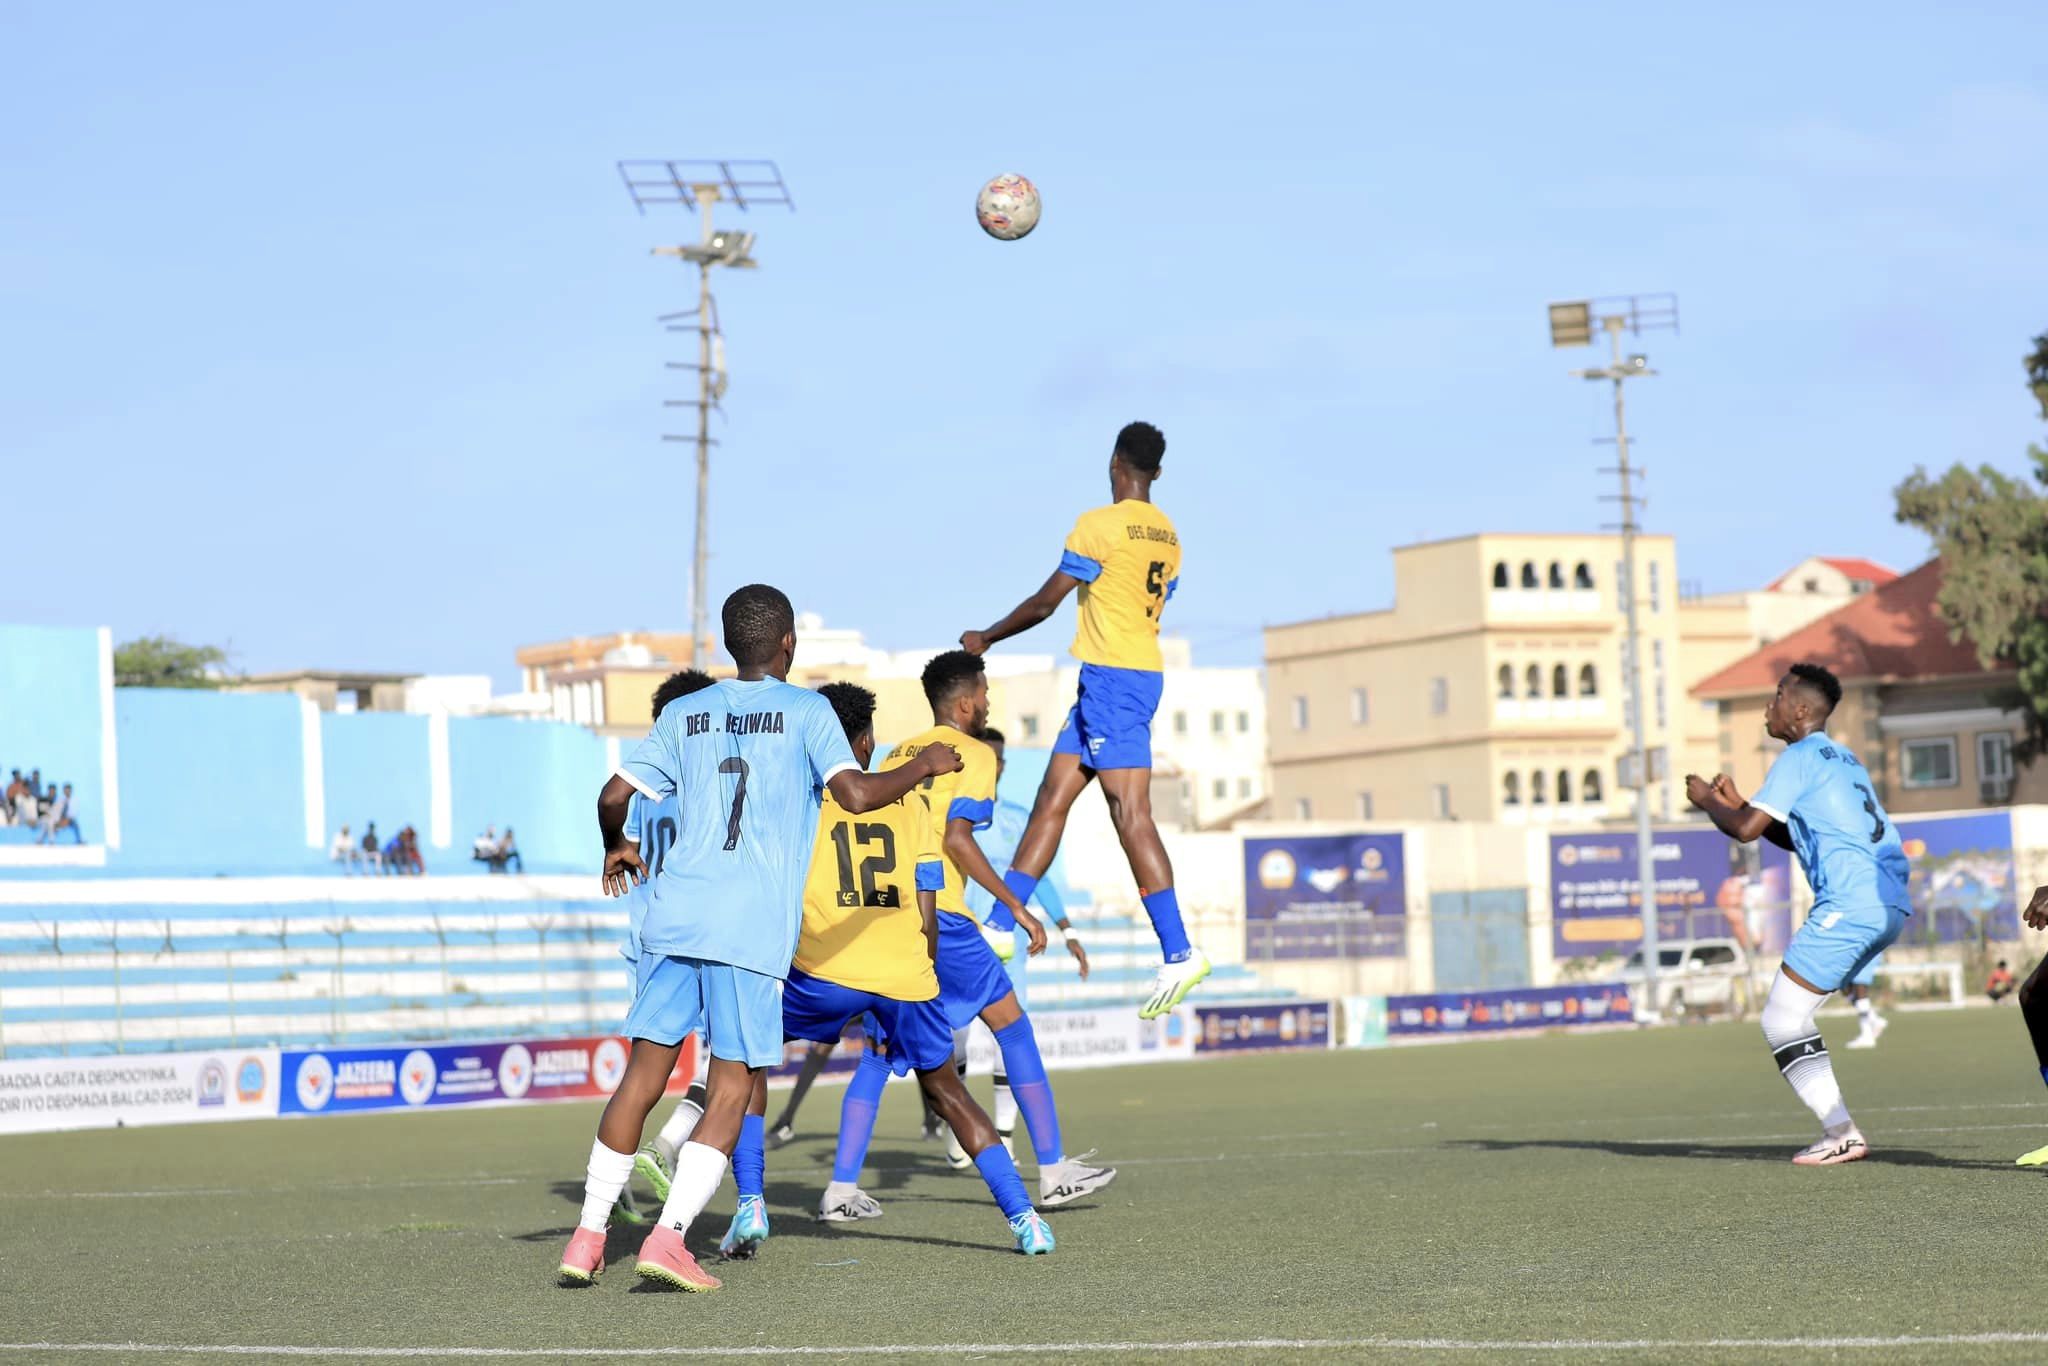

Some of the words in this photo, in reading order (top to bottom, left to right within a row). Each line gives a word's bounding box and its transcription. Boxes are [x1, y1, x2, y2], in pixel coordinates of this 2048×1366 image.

[686, 711, 710, 737] DEG
[718, 756, 750, 850] 7
[1854, 782, 1885, 843] 3
[830, 820, 900, 907] 12
